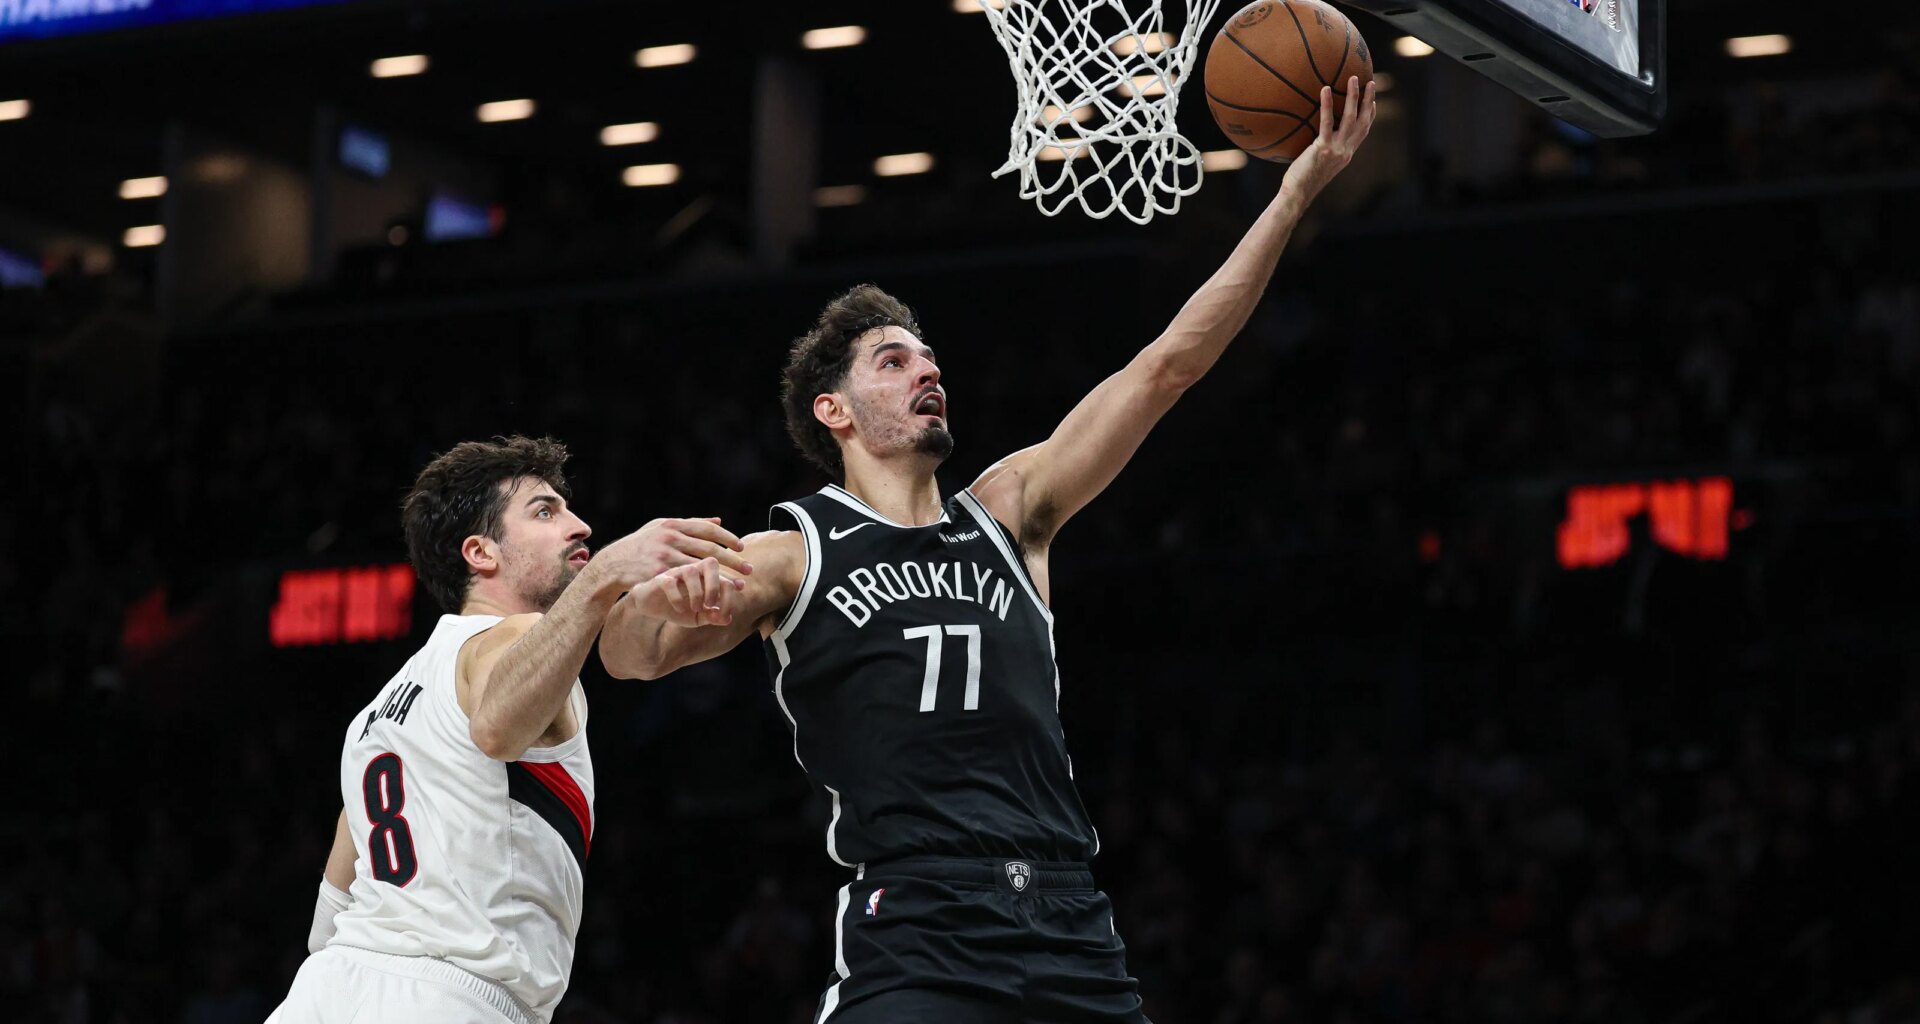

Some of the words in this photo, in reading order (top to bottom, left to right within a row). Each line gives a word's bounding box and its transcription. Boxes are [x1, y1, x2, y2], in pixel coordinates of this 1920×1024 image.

[955, 530, 981, 542] Won
[826, 561, 1015, 628] BROOKLYN
[903, 624, 982, 713] 77
[357, 681, 424, 743] AIJA
[362, 752, 418, 889] 8
[1008, 864, 1029, 876] NETS
